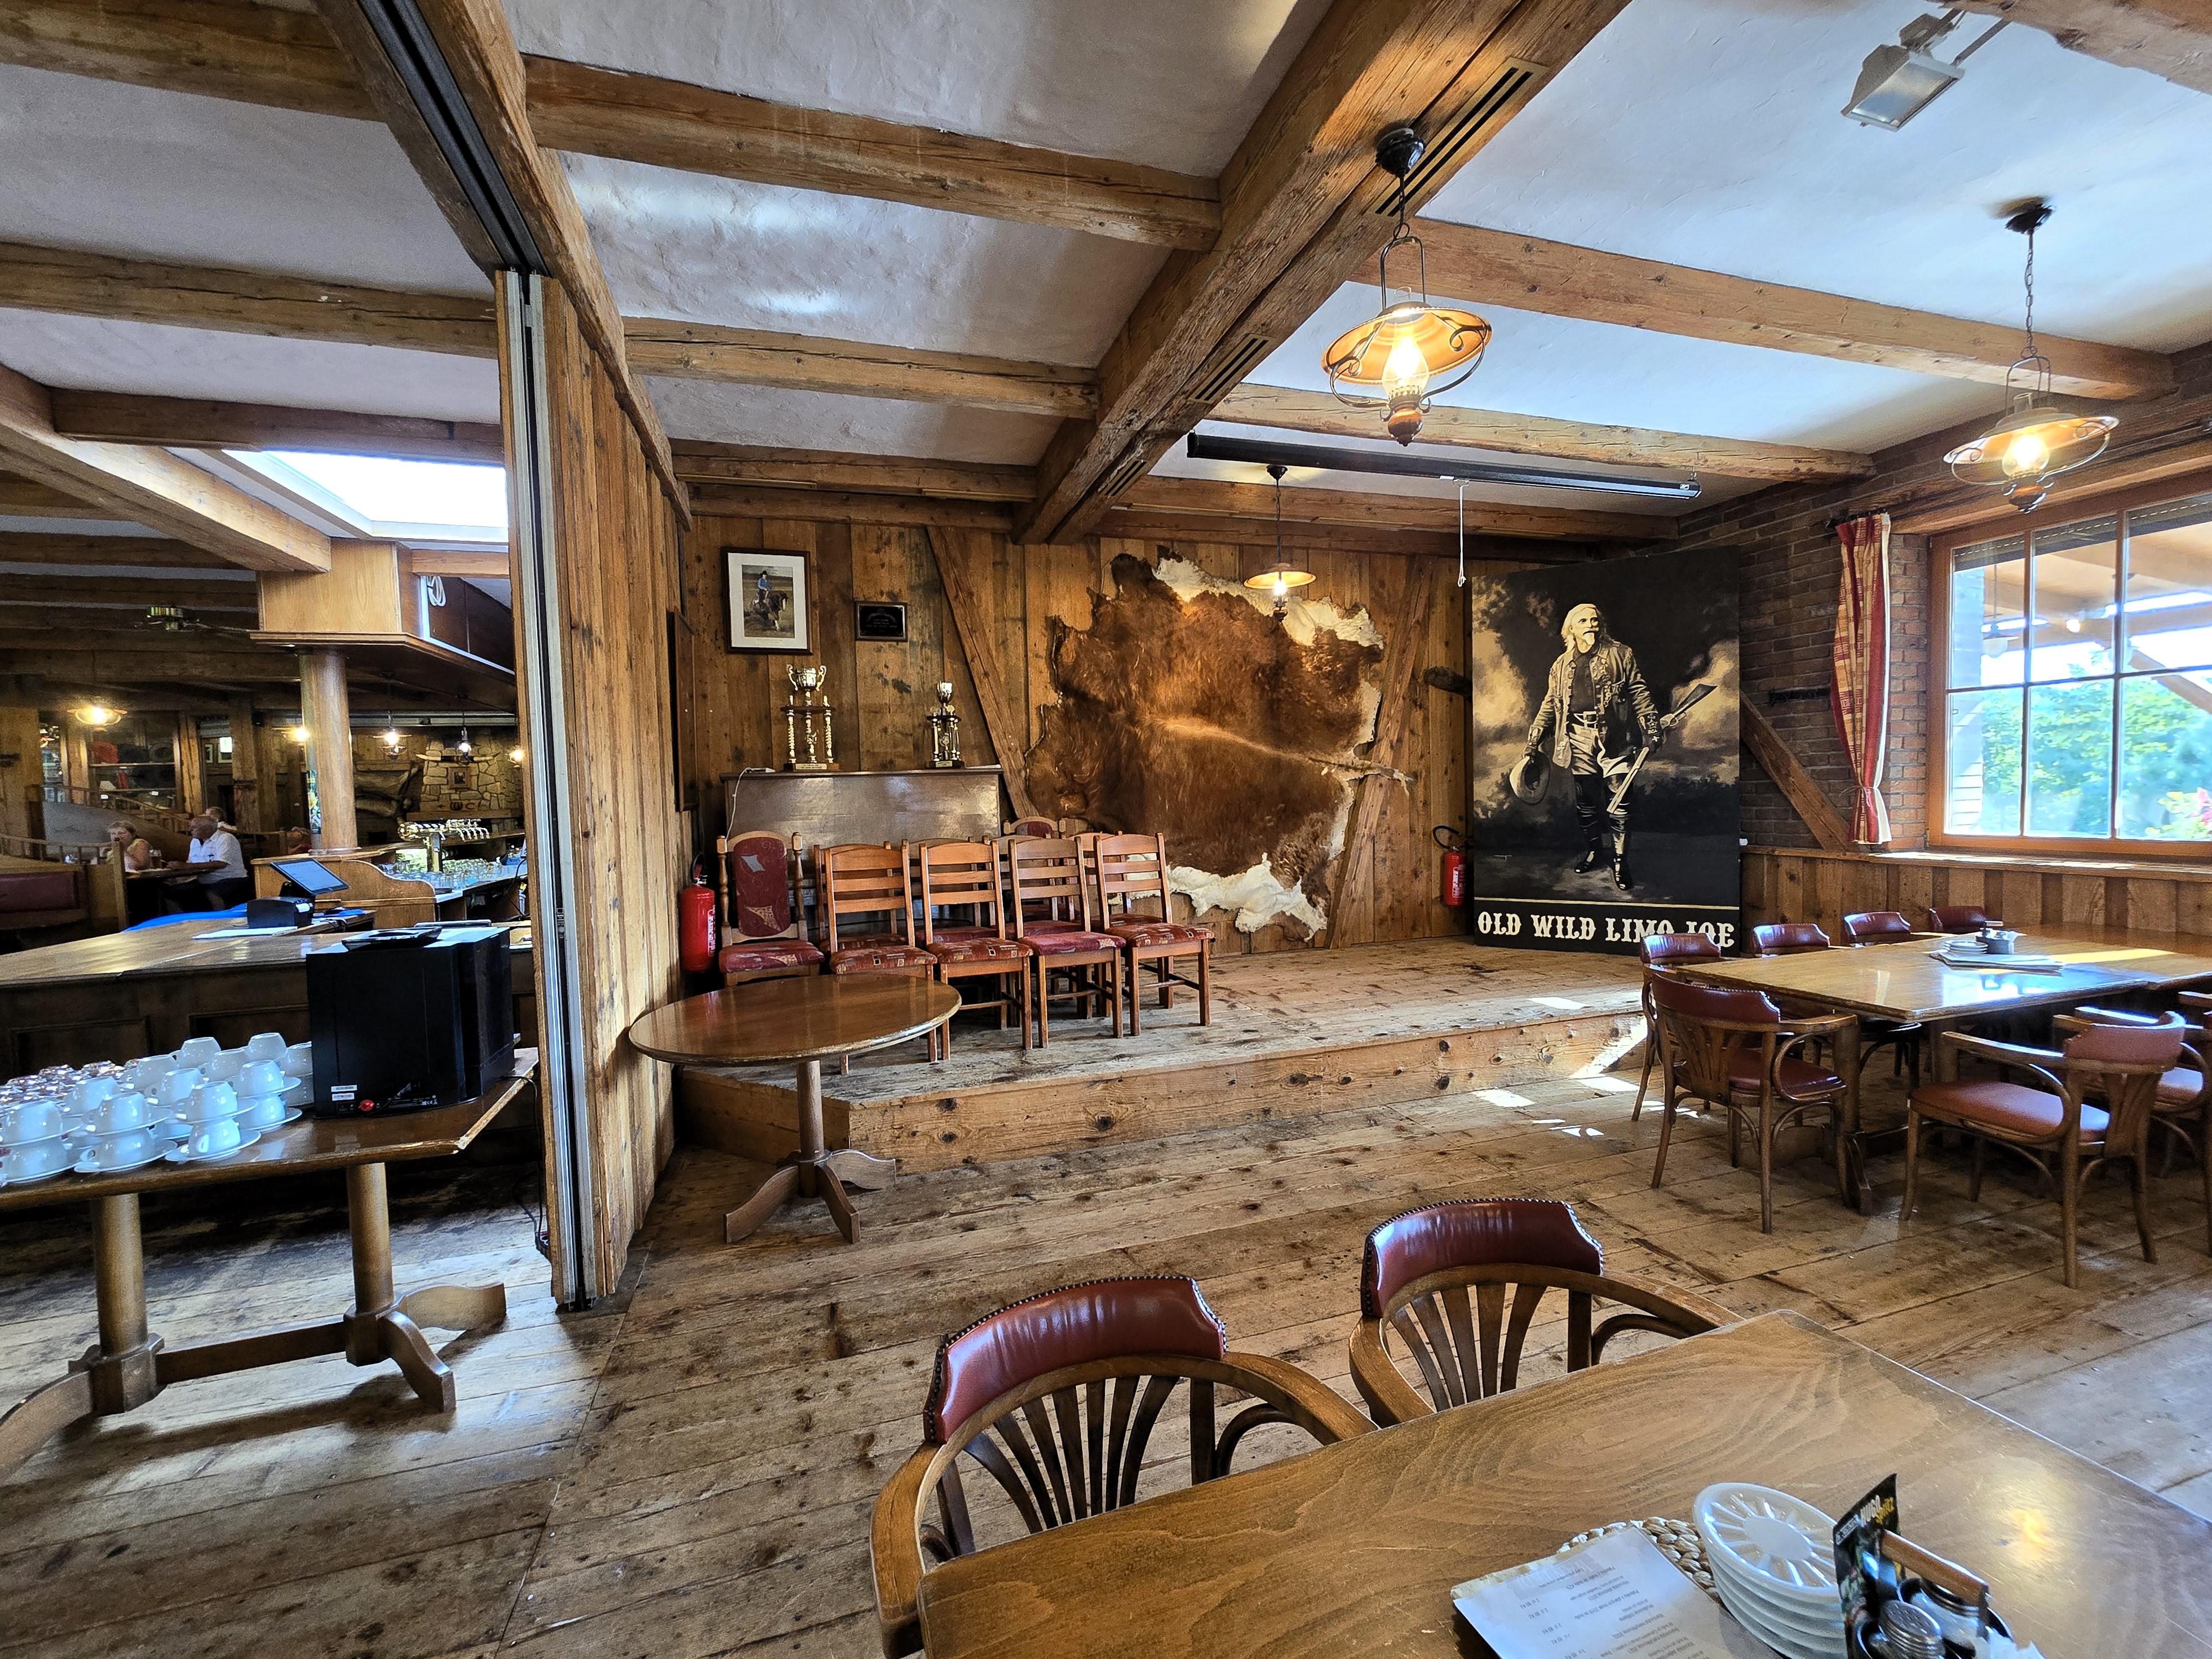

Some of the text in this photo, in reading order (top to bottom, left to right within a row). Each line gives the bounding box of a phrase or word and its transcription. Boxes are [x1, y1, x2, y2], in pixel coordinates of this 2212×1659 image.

[1478, 911, 1521, 935] OLD
[1531, 914, 1596, 940] WILD
[1605, 917, 1674, 942] LIMO
